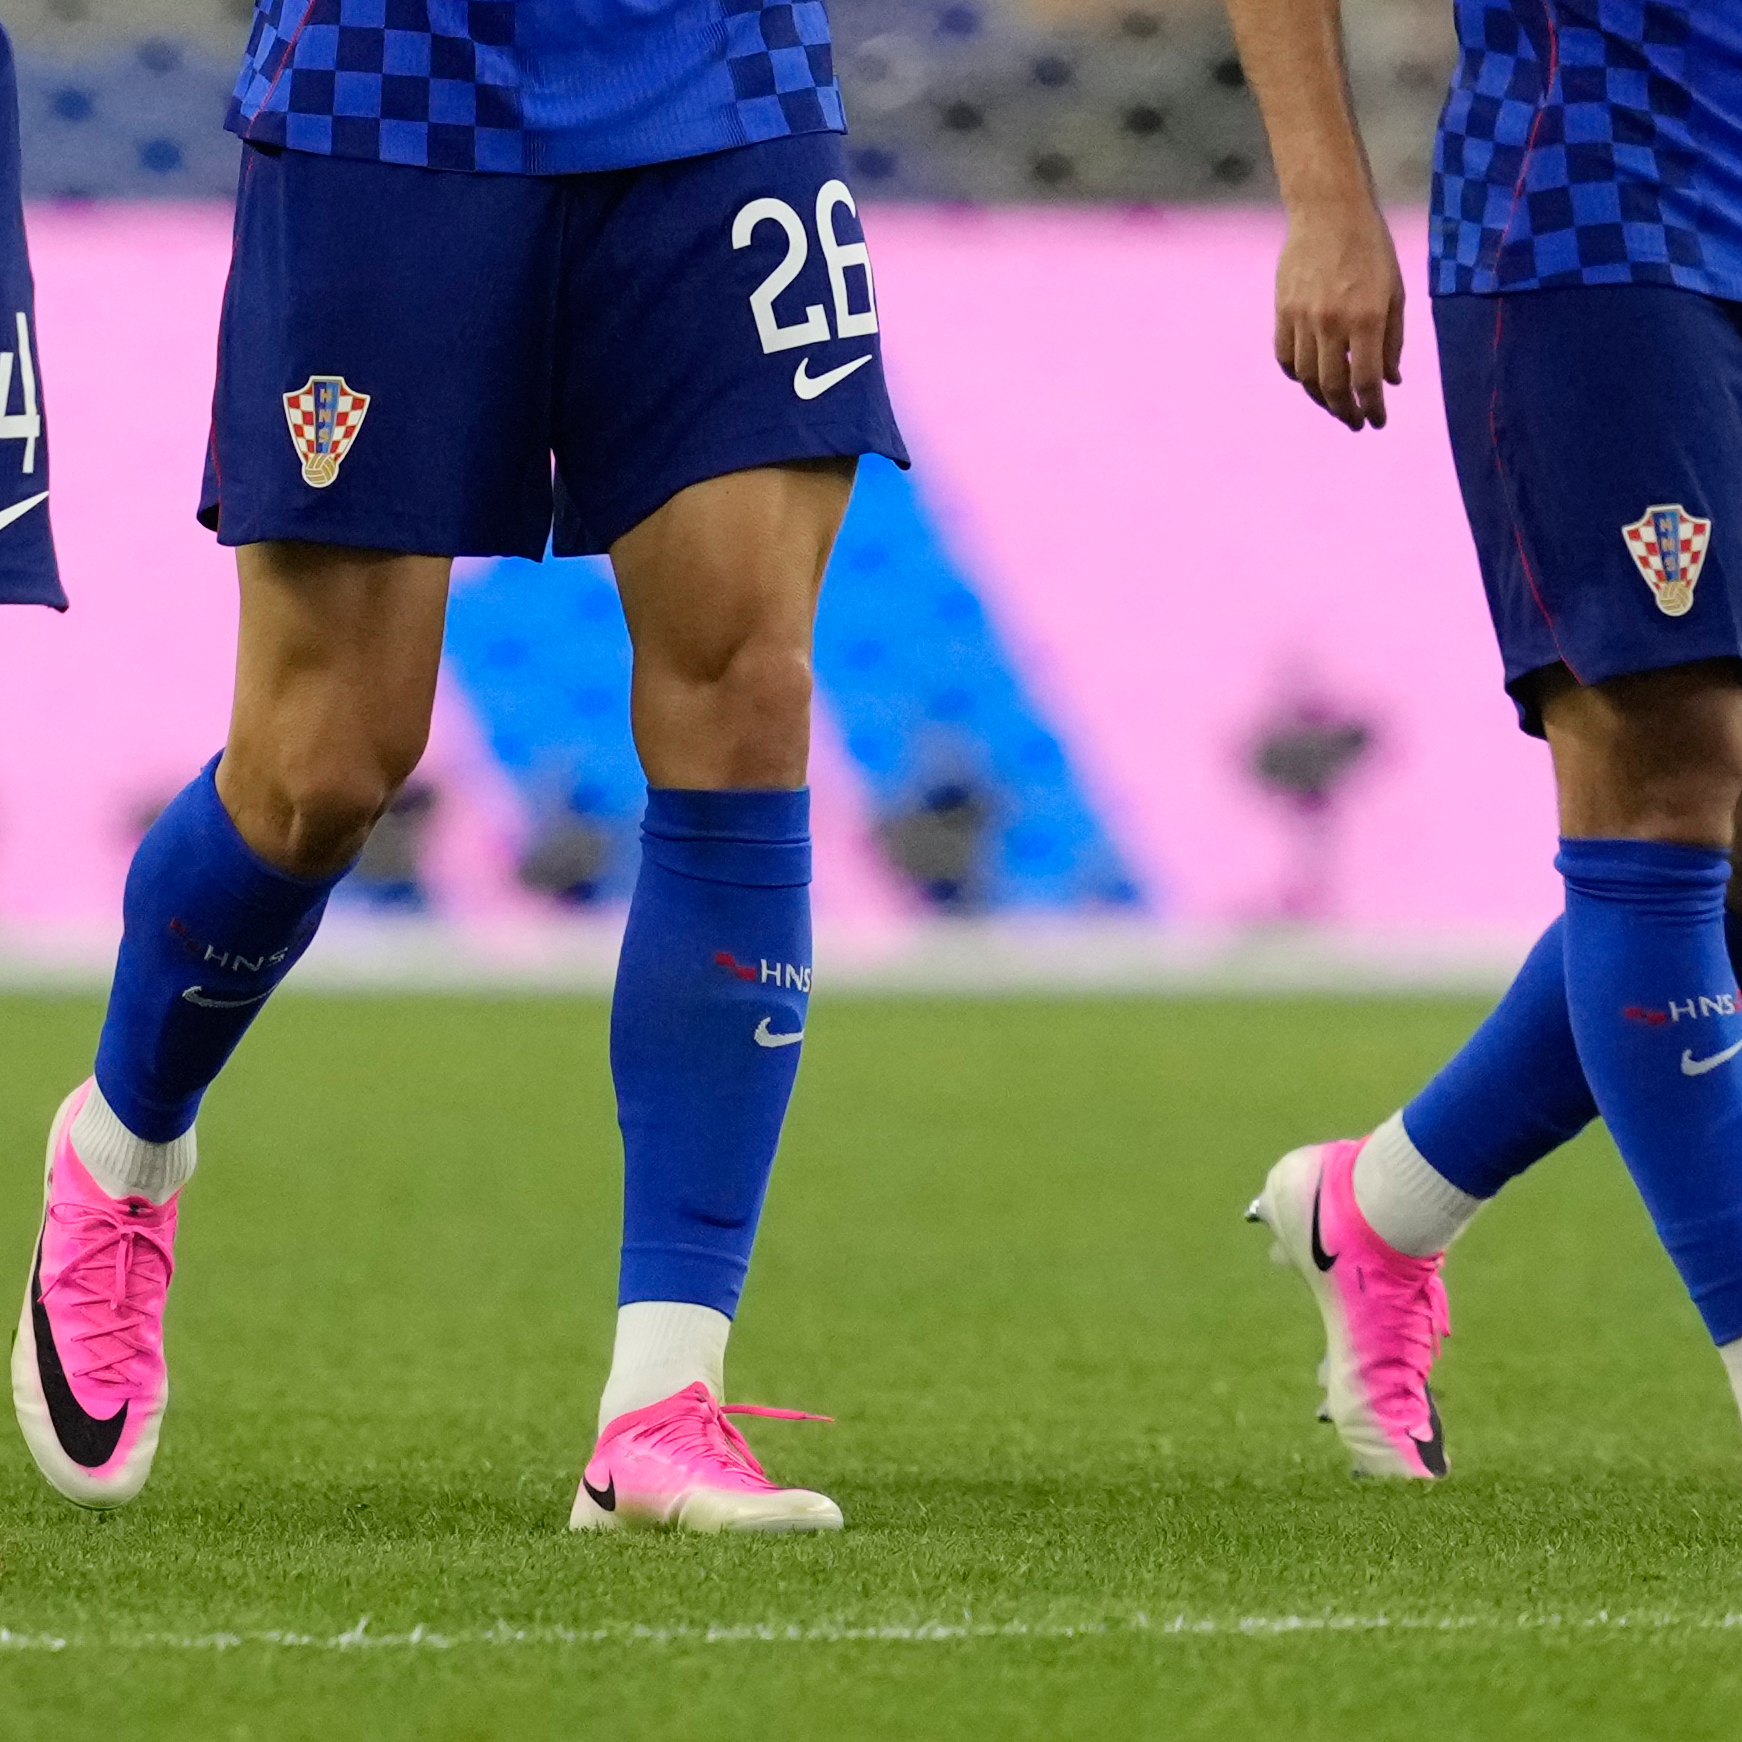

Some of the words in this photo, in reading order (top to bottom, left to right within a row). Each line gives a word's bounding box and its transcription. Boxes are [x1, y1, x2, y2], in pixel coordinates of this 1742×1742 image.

[732, 179, 880, 355] 26
[760, 958, 811, 994] HNS
[1667, 993, 1736, 1023] HNS
